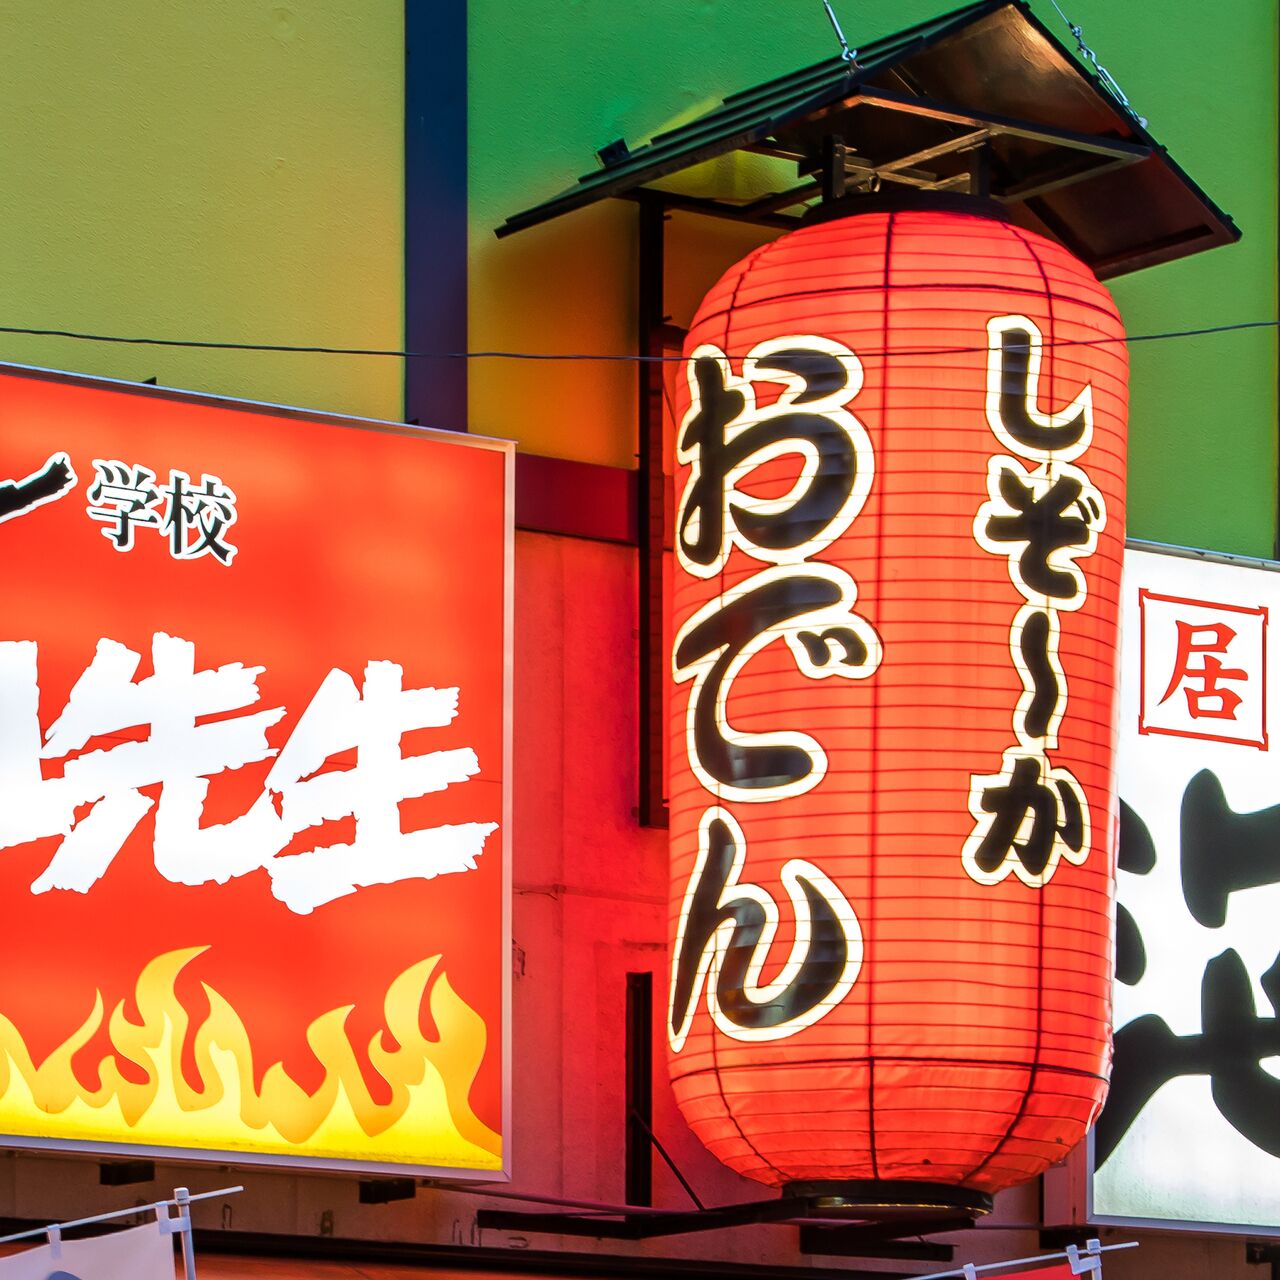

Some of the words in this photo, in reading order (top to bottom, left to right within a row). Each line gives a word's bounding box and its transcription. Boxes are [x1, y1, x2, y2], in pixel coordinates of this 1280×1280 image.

[86, 458, 239, 567] 学校
[668, 334, 884, 1054] おでん
